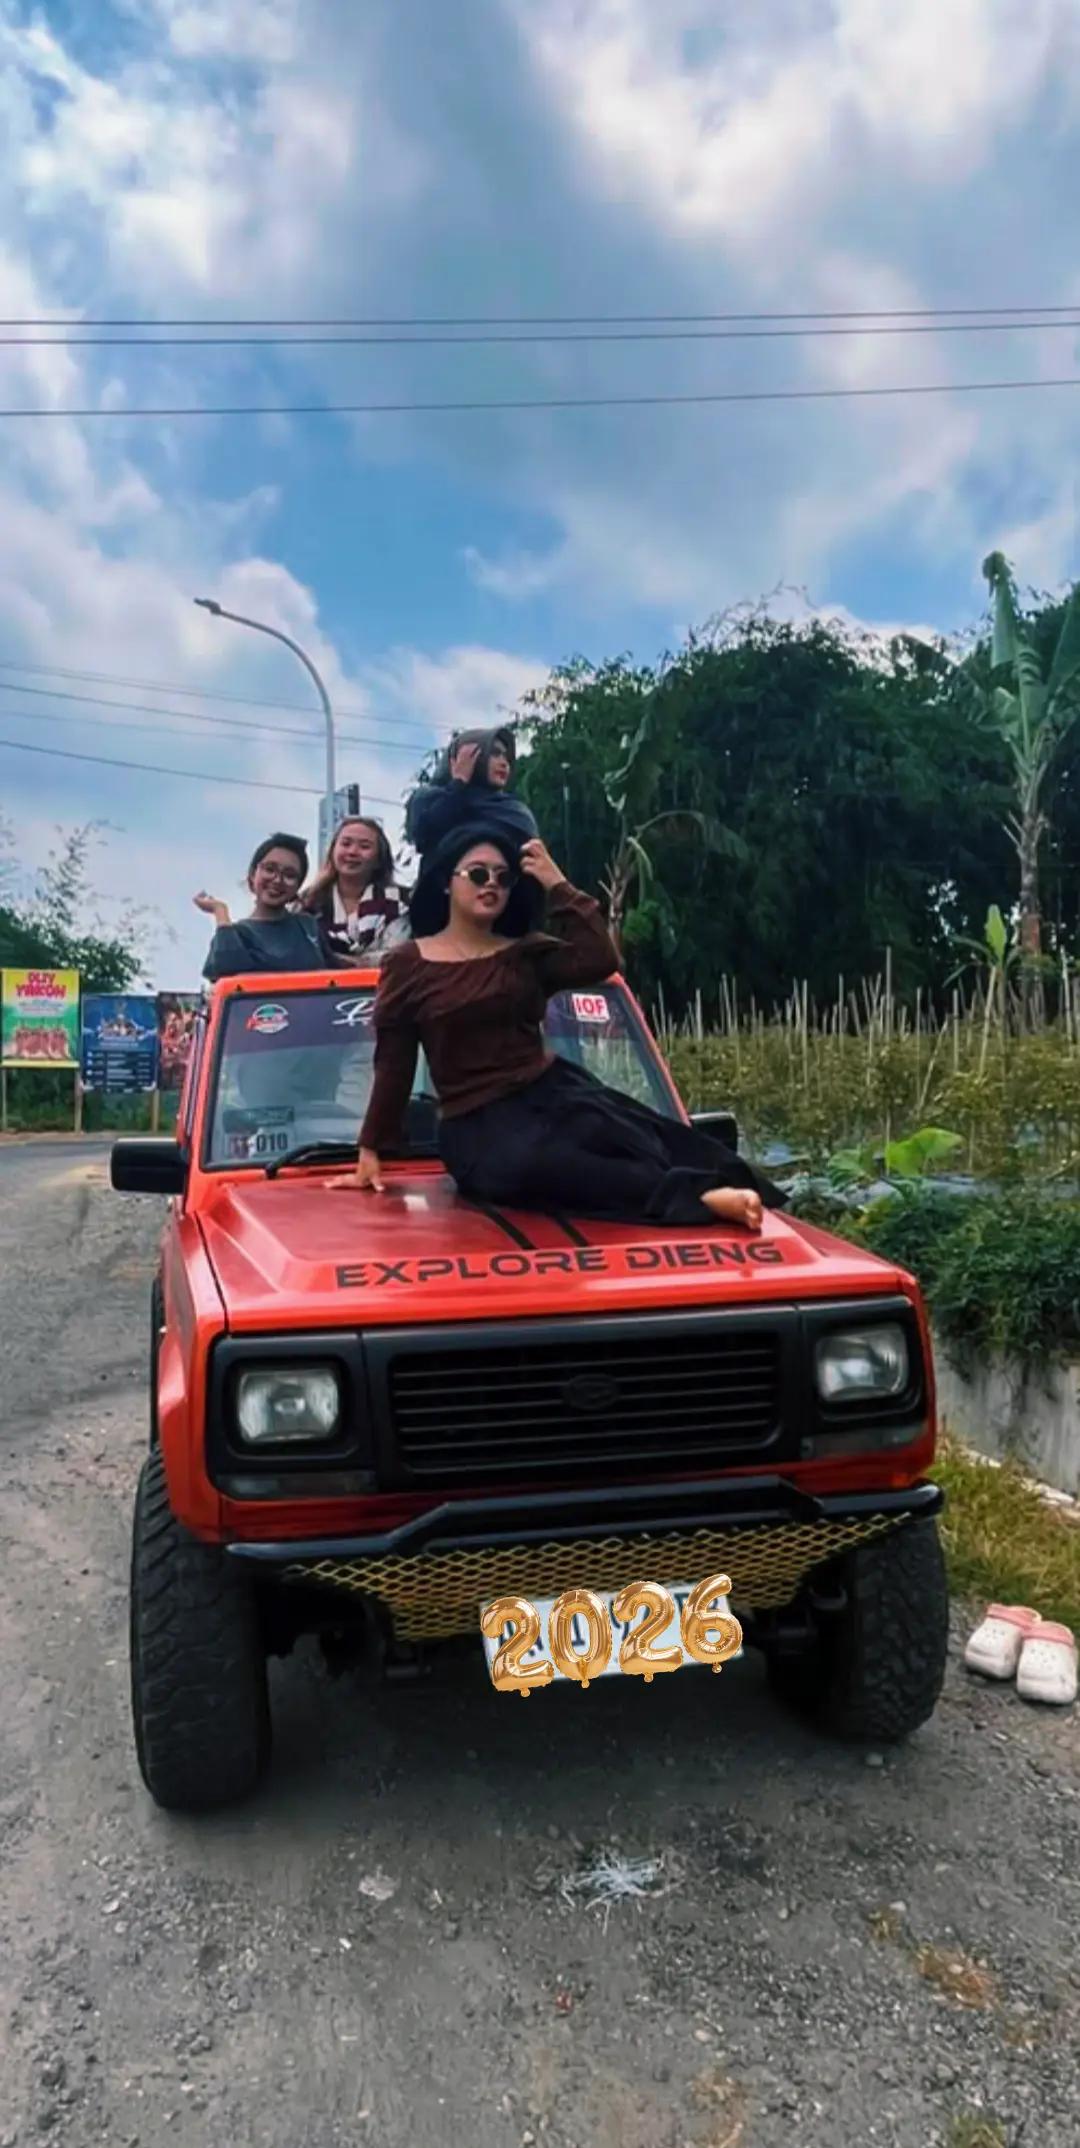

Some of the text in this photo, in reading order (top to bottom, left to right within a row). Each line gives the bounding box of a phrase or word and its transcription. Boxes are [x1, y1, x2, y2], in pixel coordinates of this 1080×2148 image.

[257, 1132, 288, 1152] 010
[336, 1240, 784, 1288] EXPLORE DIENG
